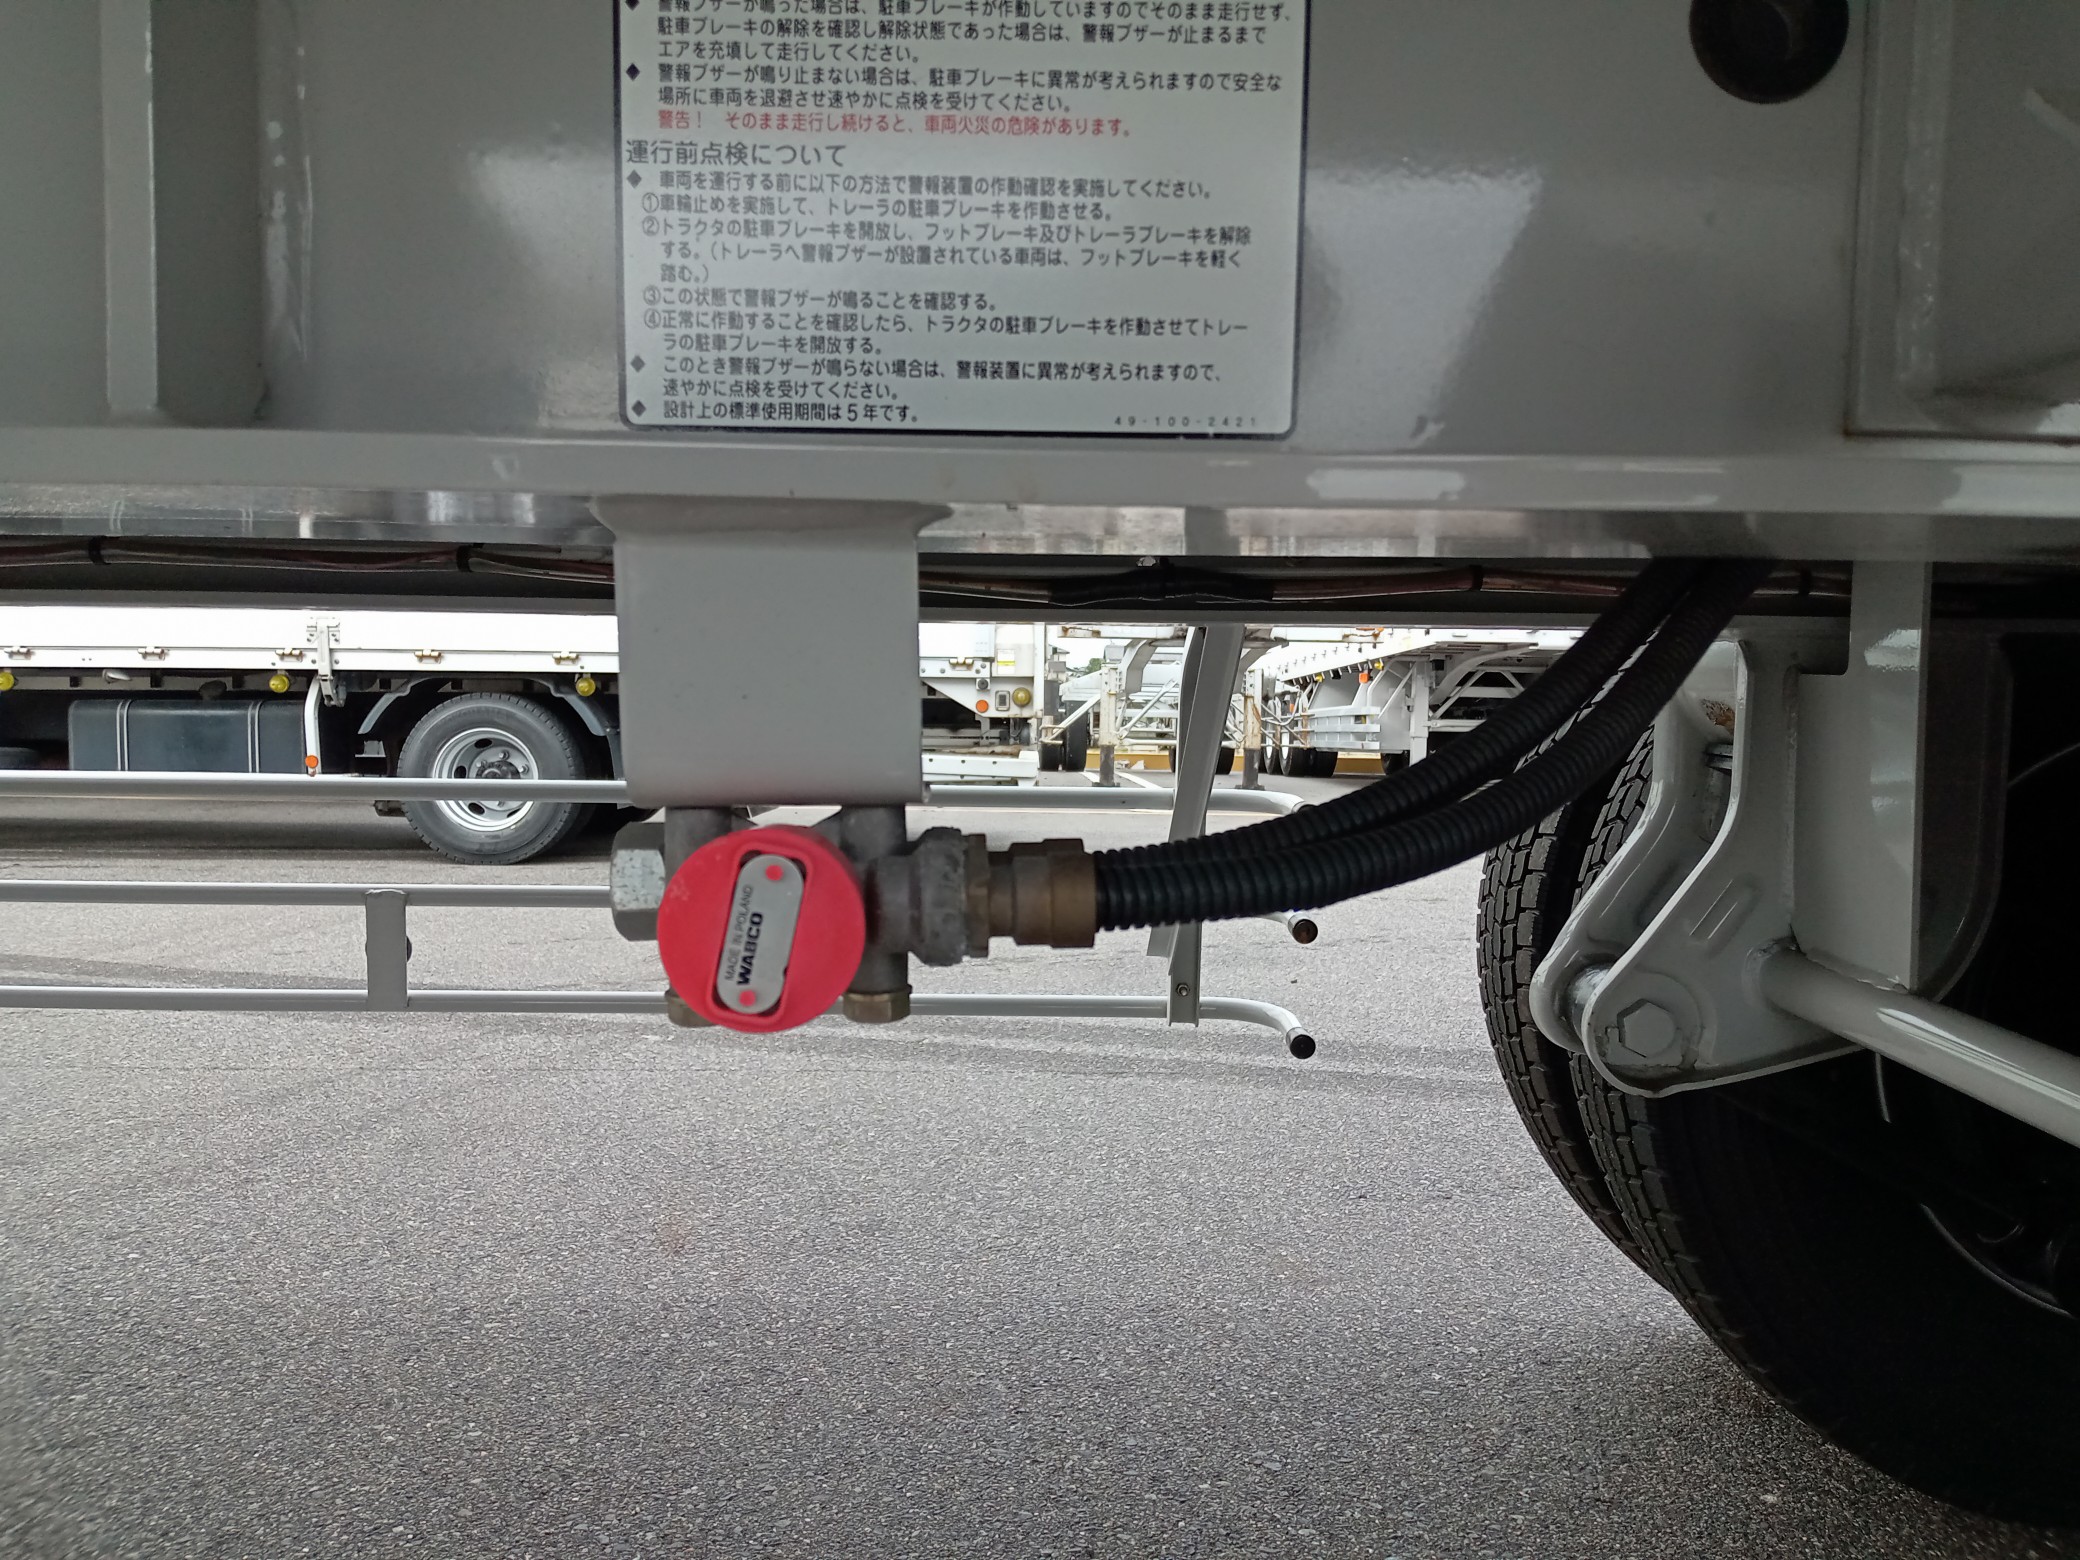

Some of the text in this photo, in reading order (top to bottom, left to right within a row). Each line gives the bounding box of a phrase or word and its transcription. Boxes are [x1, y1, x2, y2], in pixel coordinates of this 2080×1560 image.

[626, 139, 847, 167] 運行前点検について
[737, 912, 763, 985] WABCO
